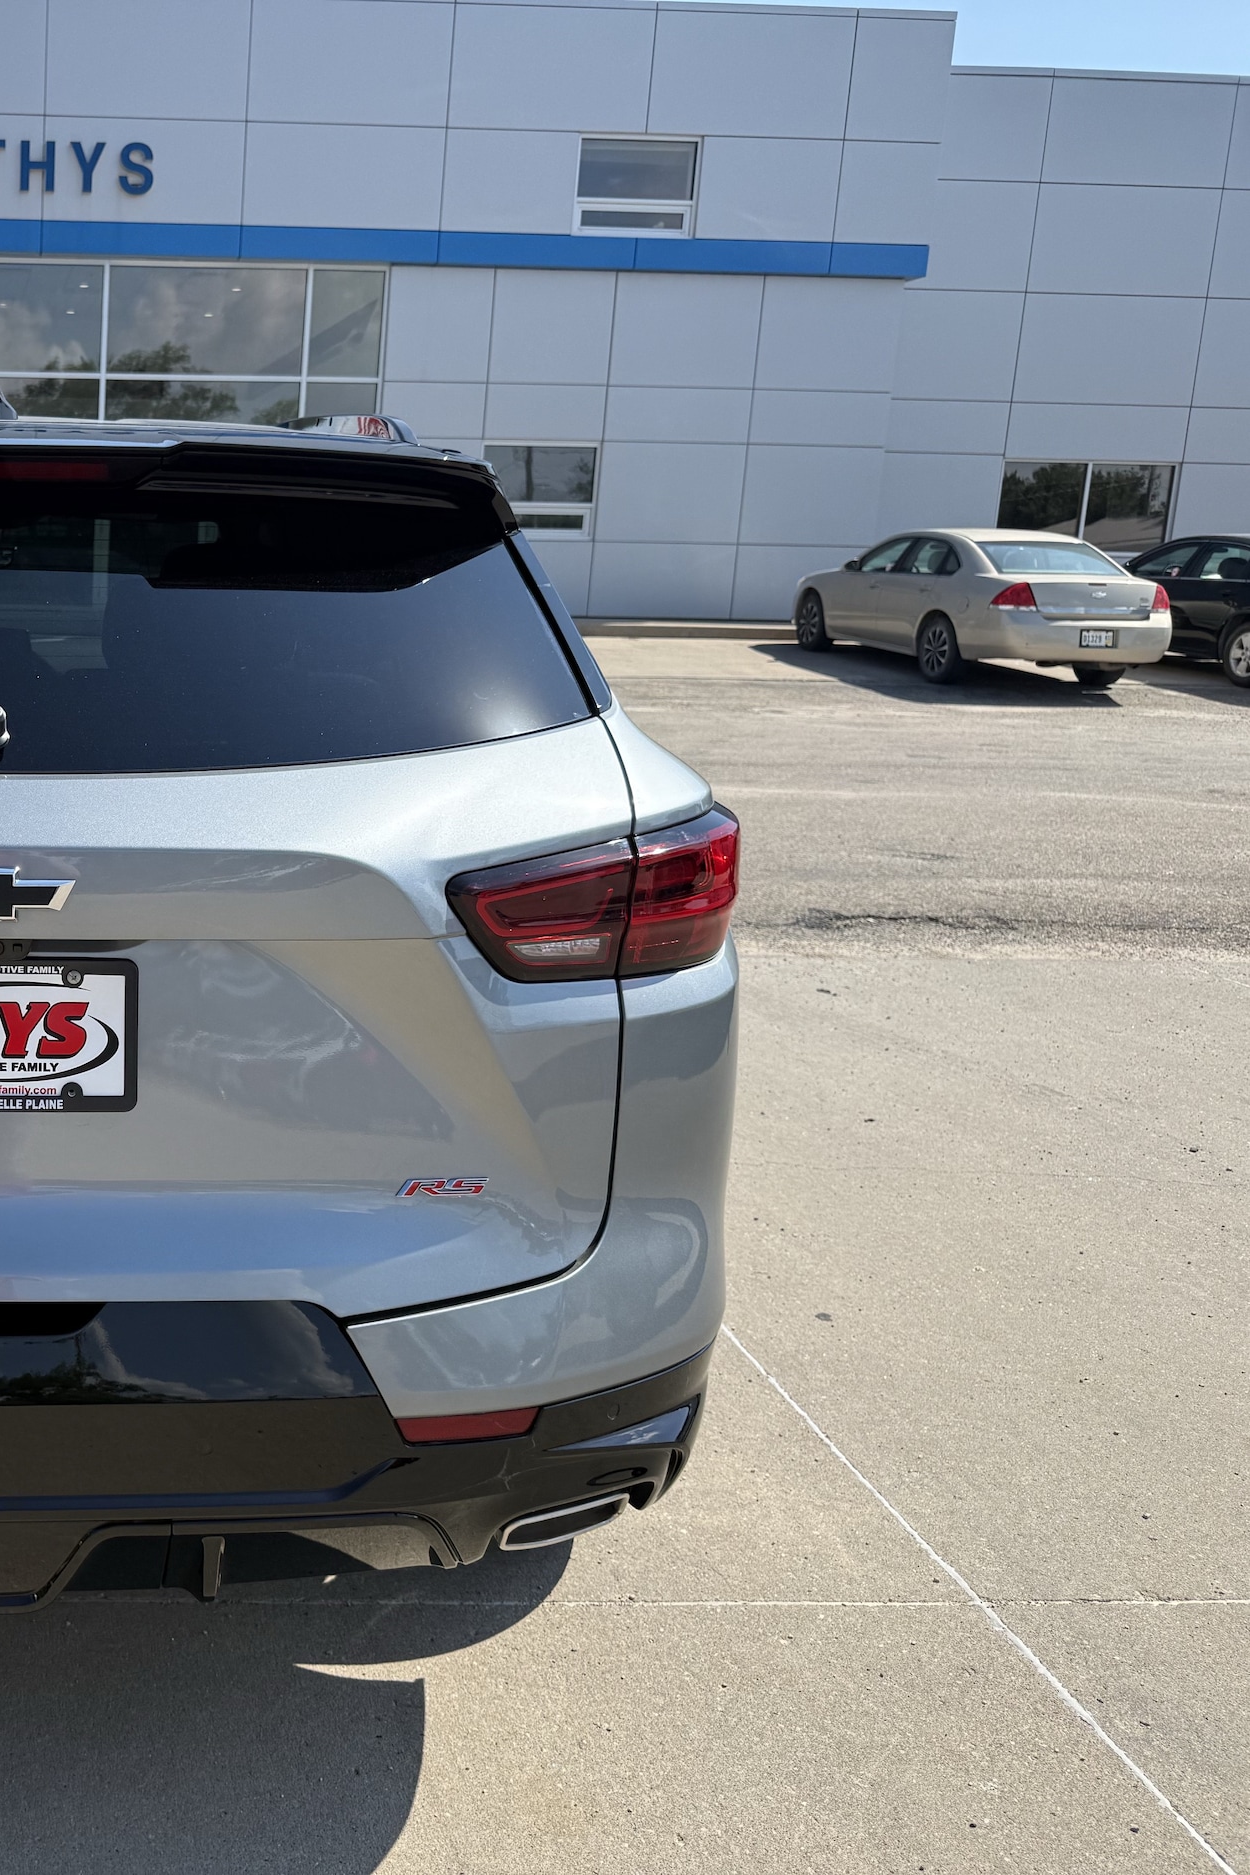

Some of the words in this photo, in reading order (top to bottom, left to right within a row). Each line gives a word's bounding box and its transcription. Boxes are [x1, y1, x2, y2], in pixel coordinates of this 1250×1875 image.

[26, 965, 65, 974] FAMILY
[11, 1062, 59, 1073] FAMILY
[25, 1098, 64, 1110] PLAINE
[395, 1177, 489, 1198] RS
